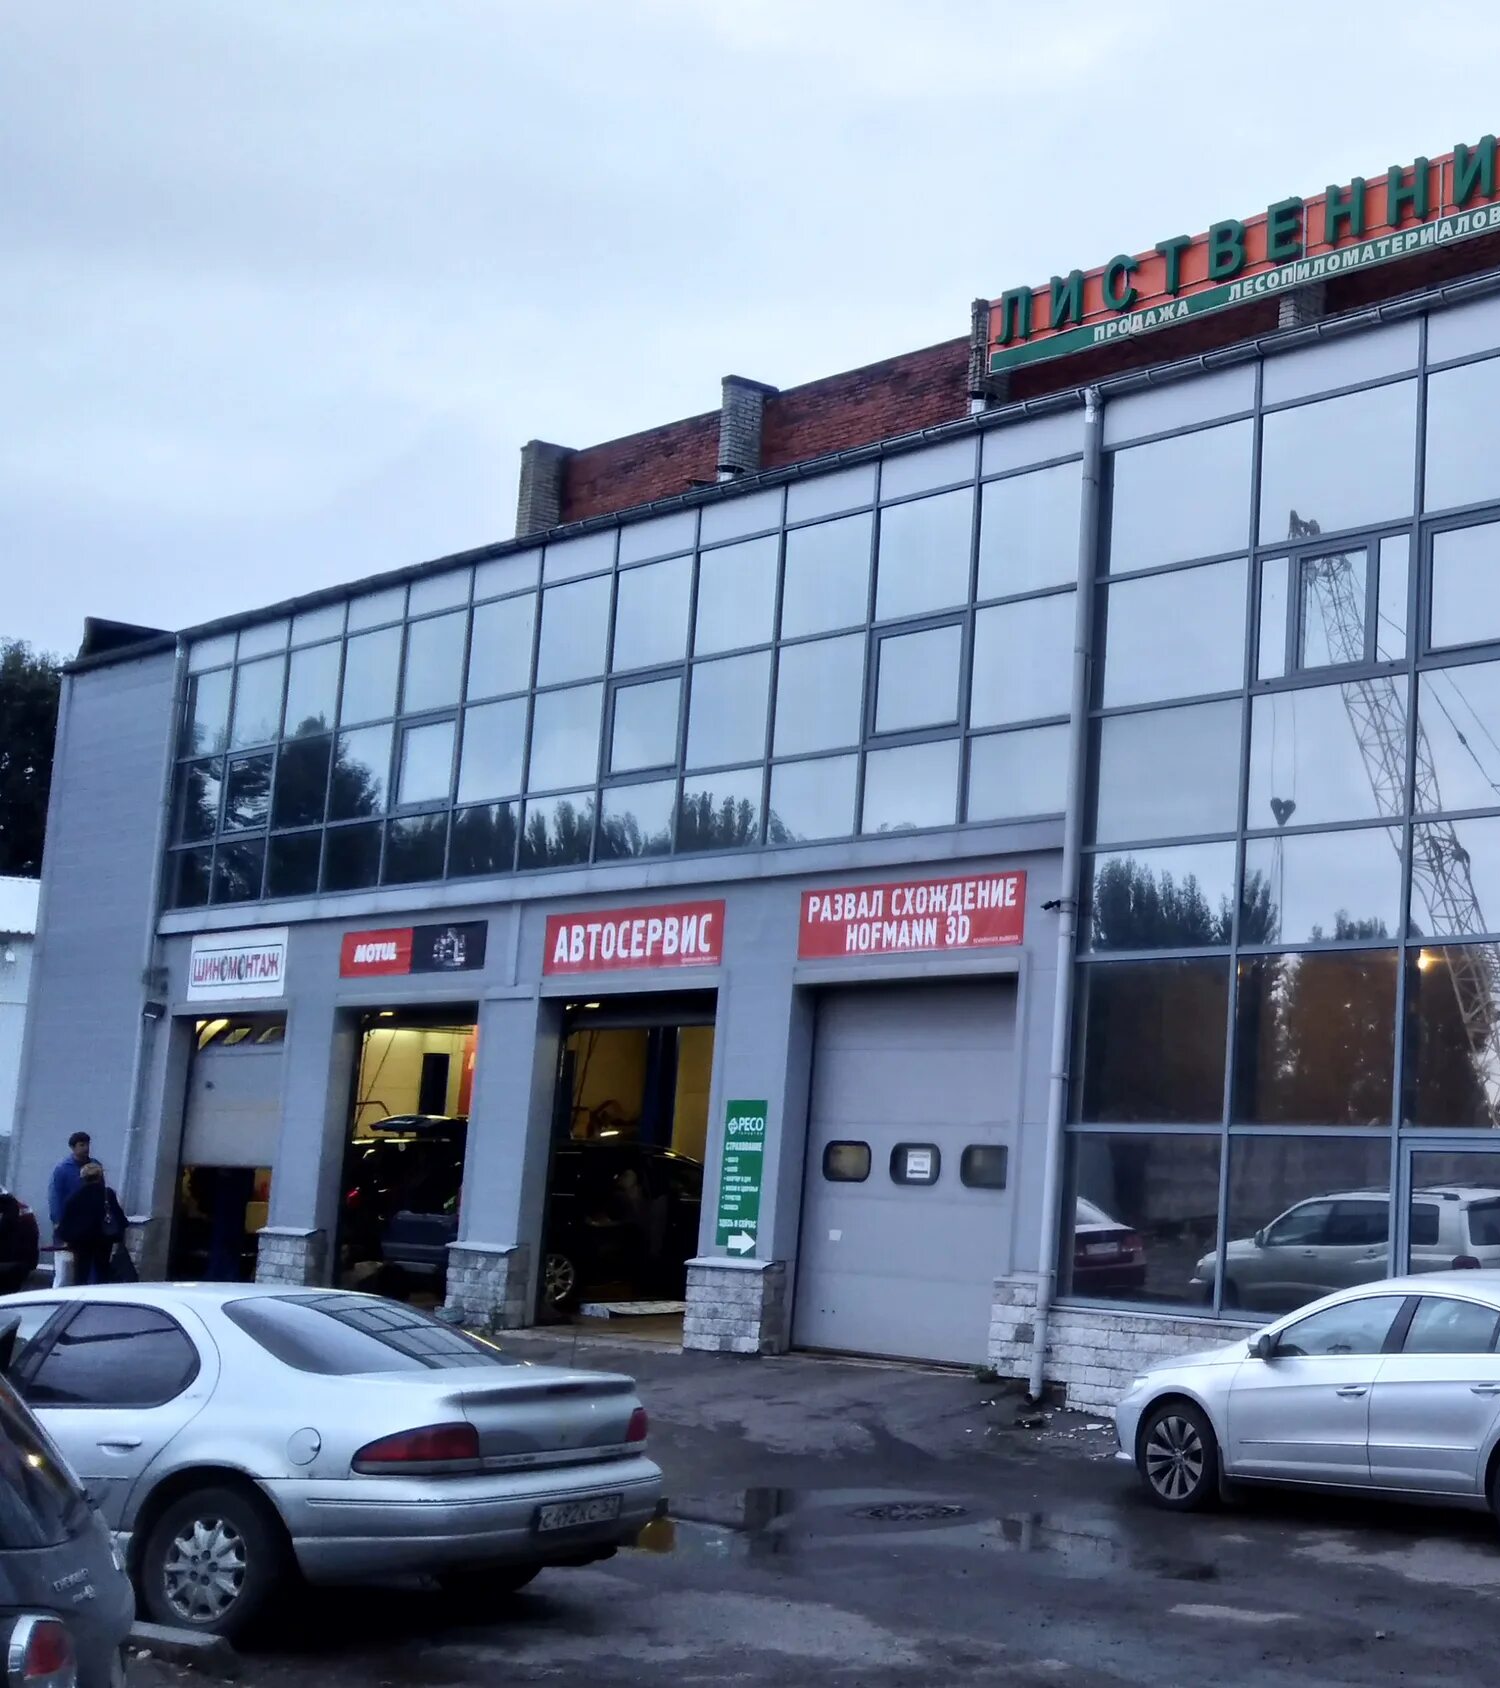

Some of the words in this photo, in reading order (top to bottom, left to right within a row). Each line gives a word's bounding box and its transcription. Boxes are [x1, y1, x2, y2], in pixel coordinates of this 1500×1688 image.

[1093, 301, 1189, 341] ПРОДАЖА
[808, 889, 884, 923] РАЗВАЛ
[891, 878, 1017, 917] СХОЖДЕНИЕ
[354, 942, 397, 963] MOTUL
[553, 912, 713, 963] АВТОСЕРВИС
[845, 920, 937, 952] HOFMANN
[945, 915, 970, 945] 3D
[194, 952, 280, 982] ШИНОМОНТАЖ
